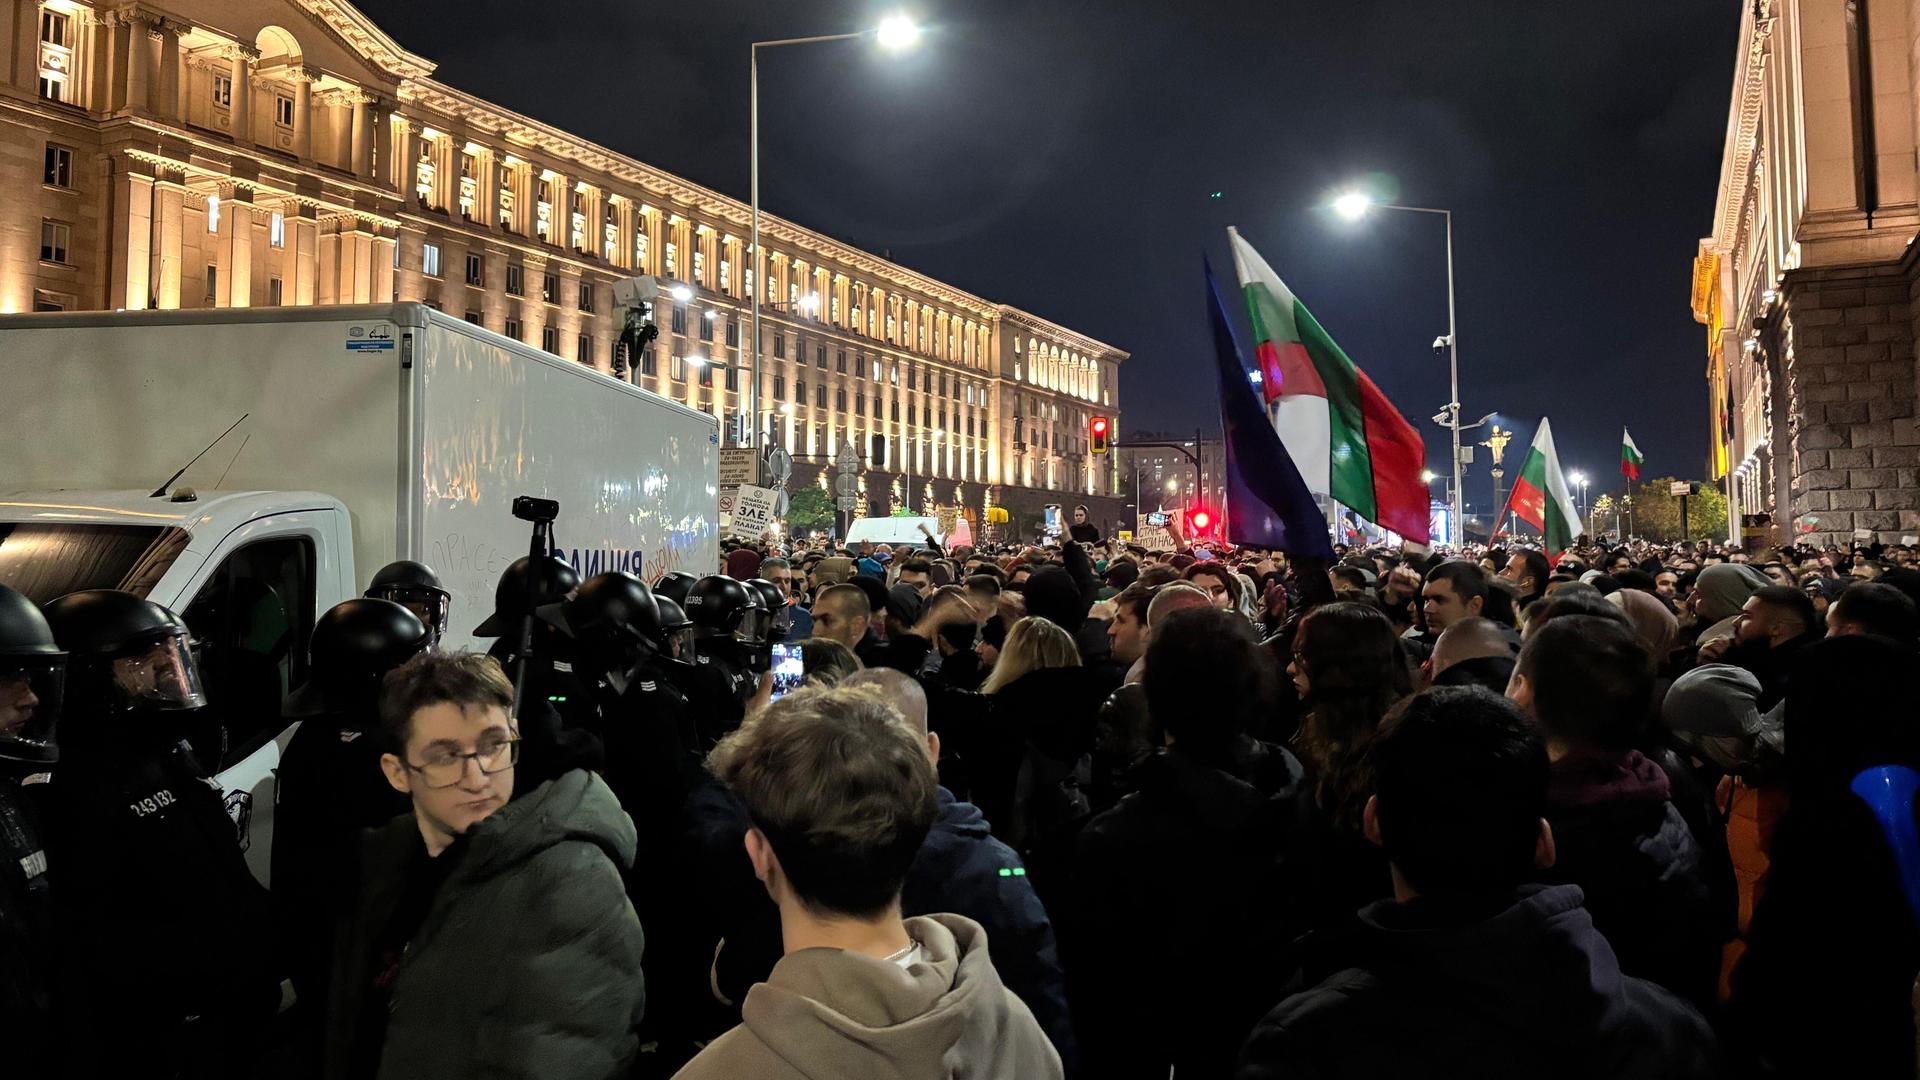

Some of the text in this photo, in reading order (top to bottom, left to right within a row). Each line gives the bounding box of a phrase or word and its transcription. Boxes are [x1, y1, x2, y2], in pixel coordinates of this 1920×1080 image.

[741, 501, 769, 511] ТОЛКОВА
[738, 506, 768, 522] ЗЛЕ,
[734, 520, 764, 532] ПЛАКАТ
